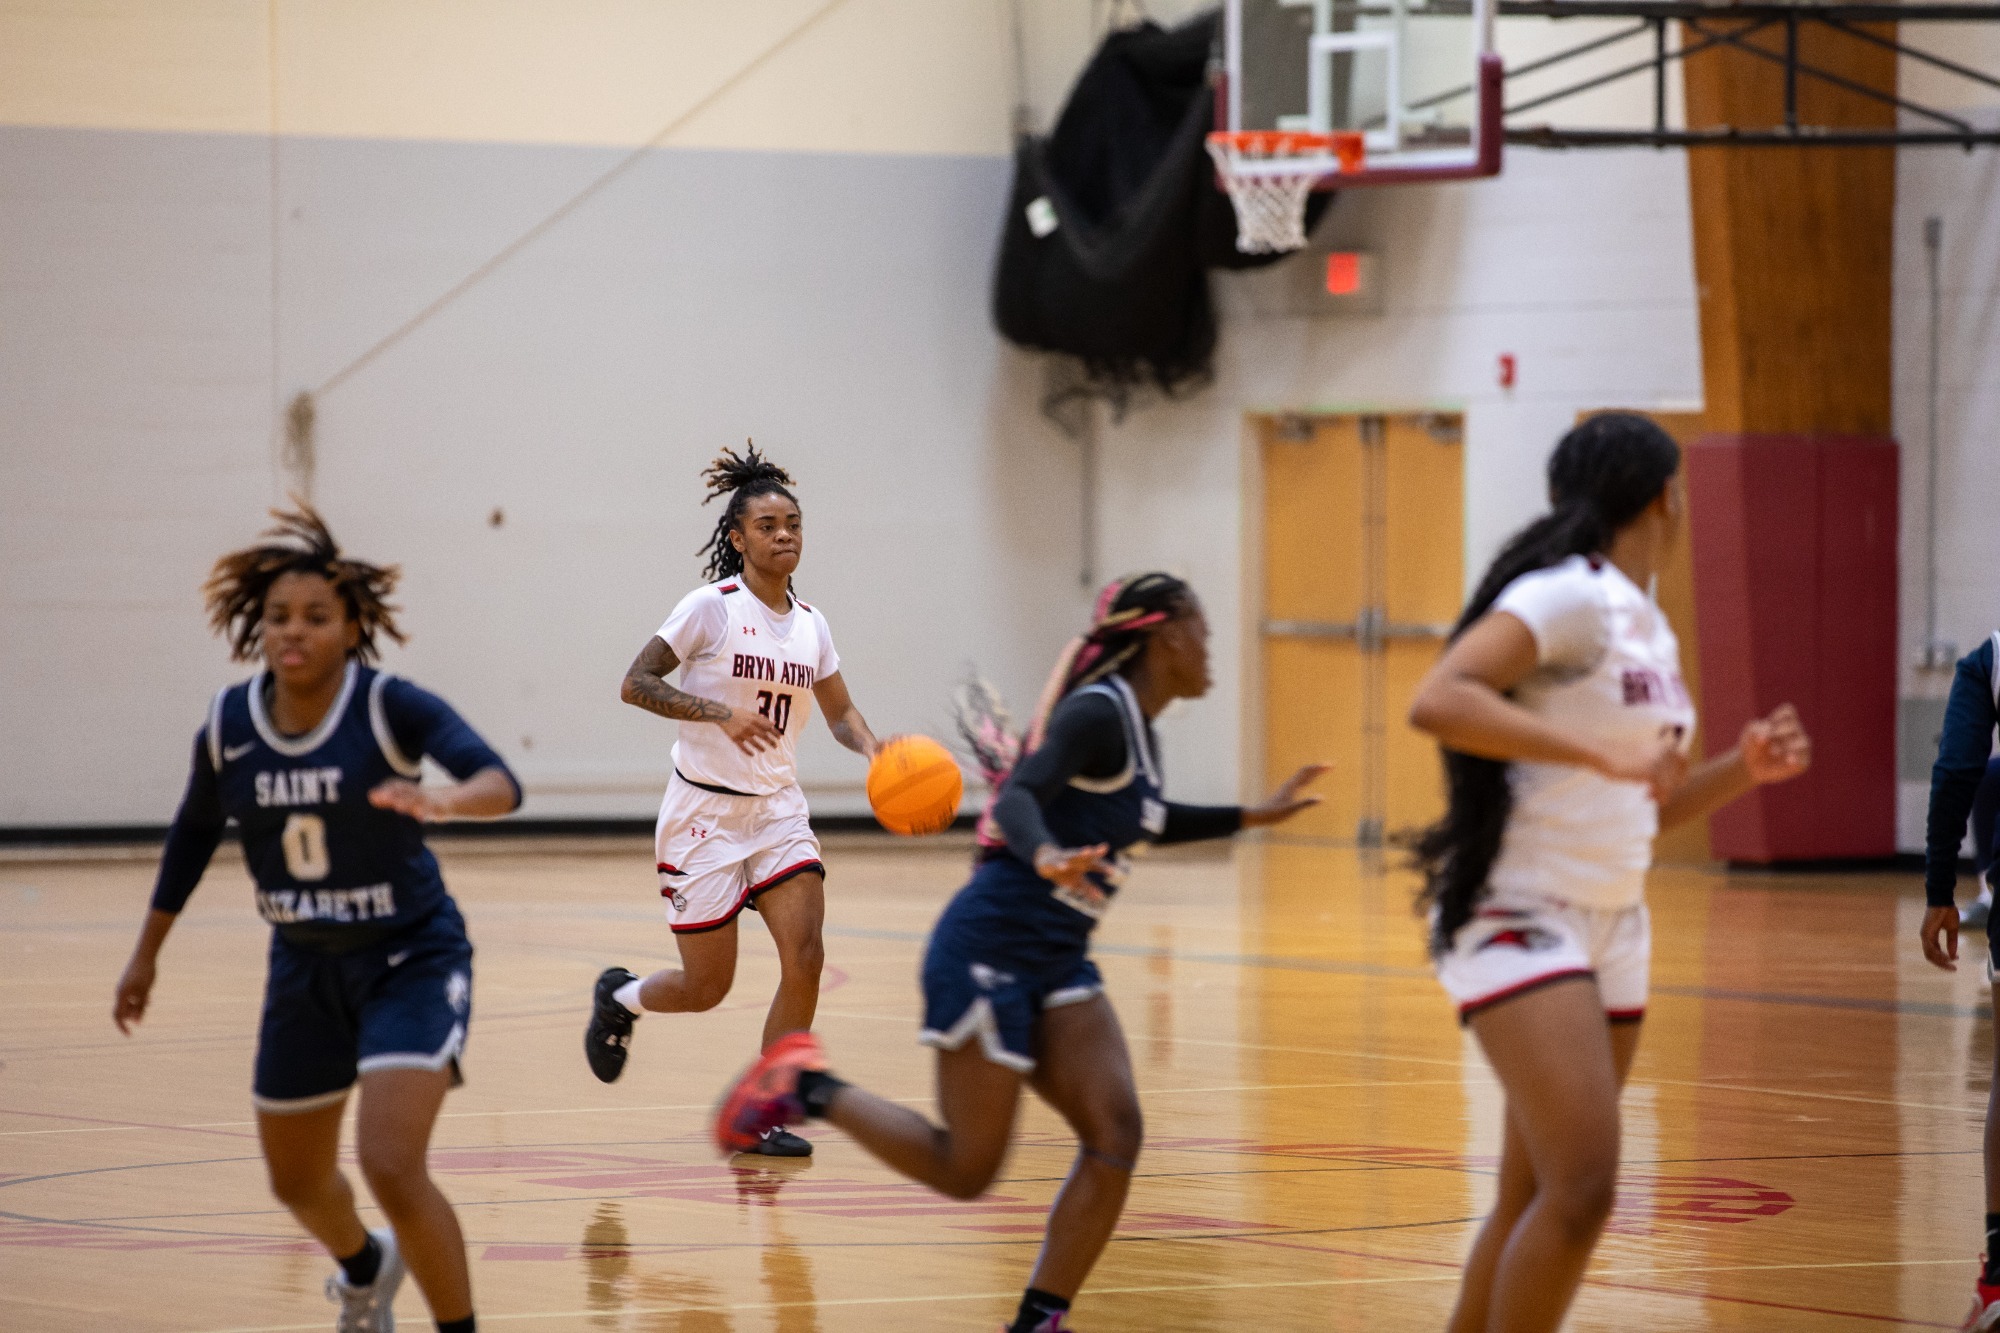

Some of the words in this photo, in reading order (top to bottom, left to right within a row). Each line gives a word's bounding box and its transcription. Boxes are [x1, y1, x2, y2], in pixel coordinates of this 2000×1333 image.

[732, 653, 775, 682] BRYN
[780, 661, 815, 690] ATHY
[756, 689, 793, 736] 30
[254, 766, 344, 808] SAINT
[280, 812, 332, 883] 0
